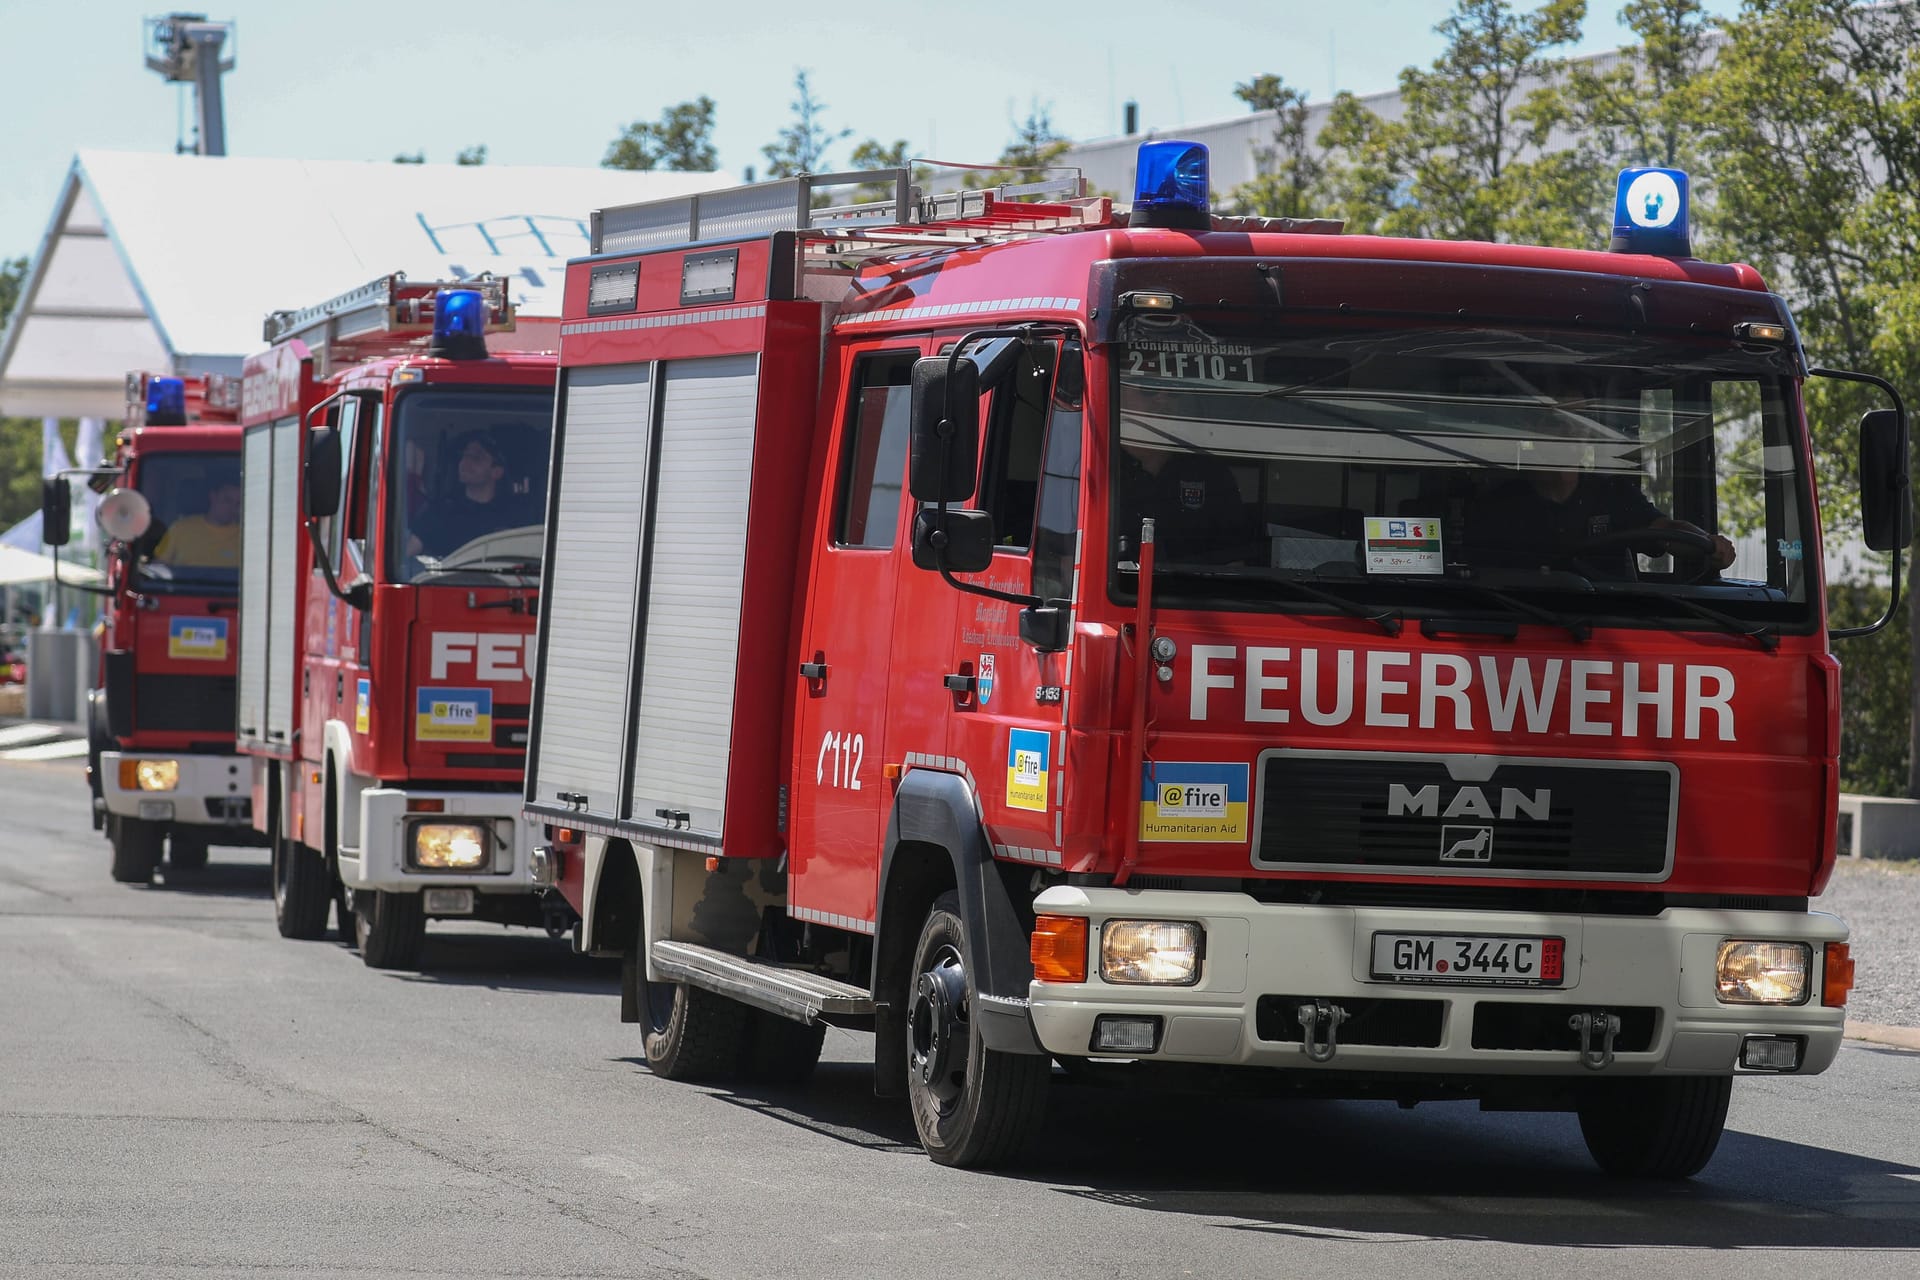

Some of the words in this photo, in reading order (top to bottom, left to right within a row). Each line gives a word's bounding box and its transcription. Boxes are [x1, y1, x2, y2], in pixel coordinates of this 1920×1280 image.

[430, 631, 537, 682] FE
[1190, 644, 1737, 741] FEUERWEHR
[434, 703, 473, 718] @fire
[832, 731, 864, 791] 112
[1017, 754, 1038, 775] @fire
[1164, 787, 1220, 806] @fire
[1387, 783, 1551, 821] MAN
[1146, 823, 1217, 833] Humanitarian
[1220, 824, 1237, 833] Aid
[1393, 939, 1434, 971] GM
[1453, 941, 1533, 973] 344C
